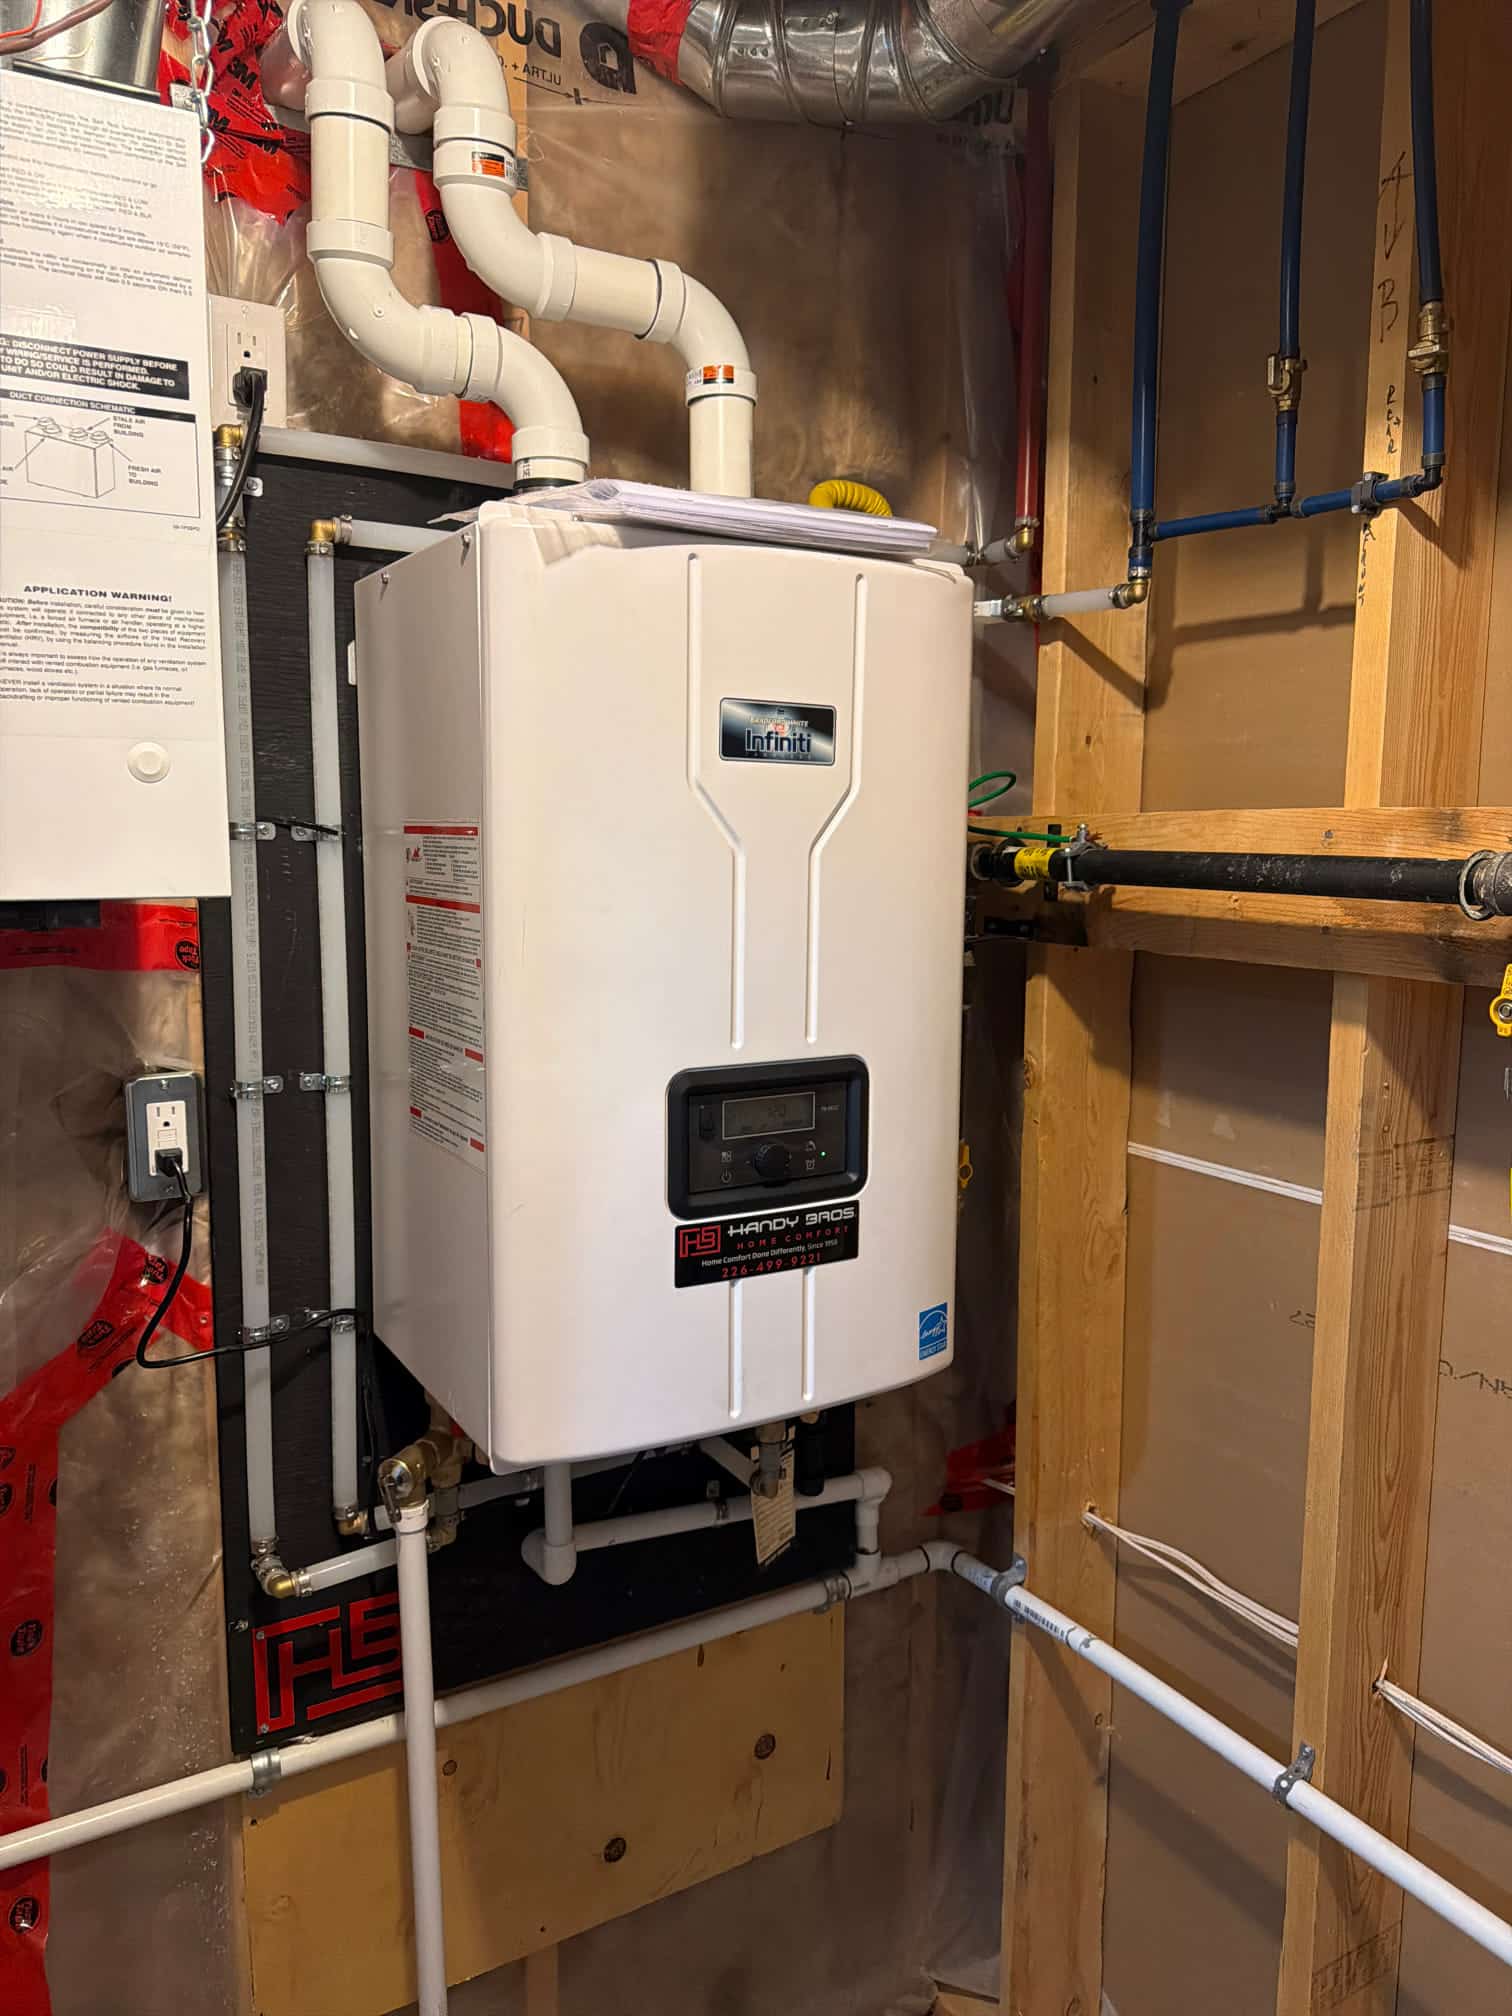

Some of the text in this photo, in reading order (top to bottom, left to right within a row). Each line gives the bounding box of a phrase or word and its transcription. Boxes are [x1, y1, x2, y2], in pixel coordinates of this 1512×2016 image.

[12, 339, 71, 355] DISCONNECT
[72, 349, 105, 361] POWER
[108, 354, 140, 366] SUPPLY
[143, 359, 178, 371] BEFORE
[0, 356, 175, 387] TO DO SO COULD RESULT IN DAMAGE TO
[1, 363, 22, 373] UNIT
[25, 367, 60, 379] AND/OR
[62, 372, 105, 386] ELECTRIC
[93, 360, 148, 375] PERFORMED.
[9, 391, 136, 415] DUCT CONNECTION SCHEMATIC
[24, 586, 173, 602] APPLICATION WARNING!
[745, 728, 812, 753] Infiniti
[727, 1216, 799, 1238] HANDY
[737, 1225, 848, 1249] HOME COMFORT
[701, 1258, 722, 1268] Home
[723, 1254, 751, 1264] Comfort
[752, 1249, 770, 1259] Done
[807, 1241, 824, 1251] Since
[721, 1252, 821, 1279] 226-499-9221
